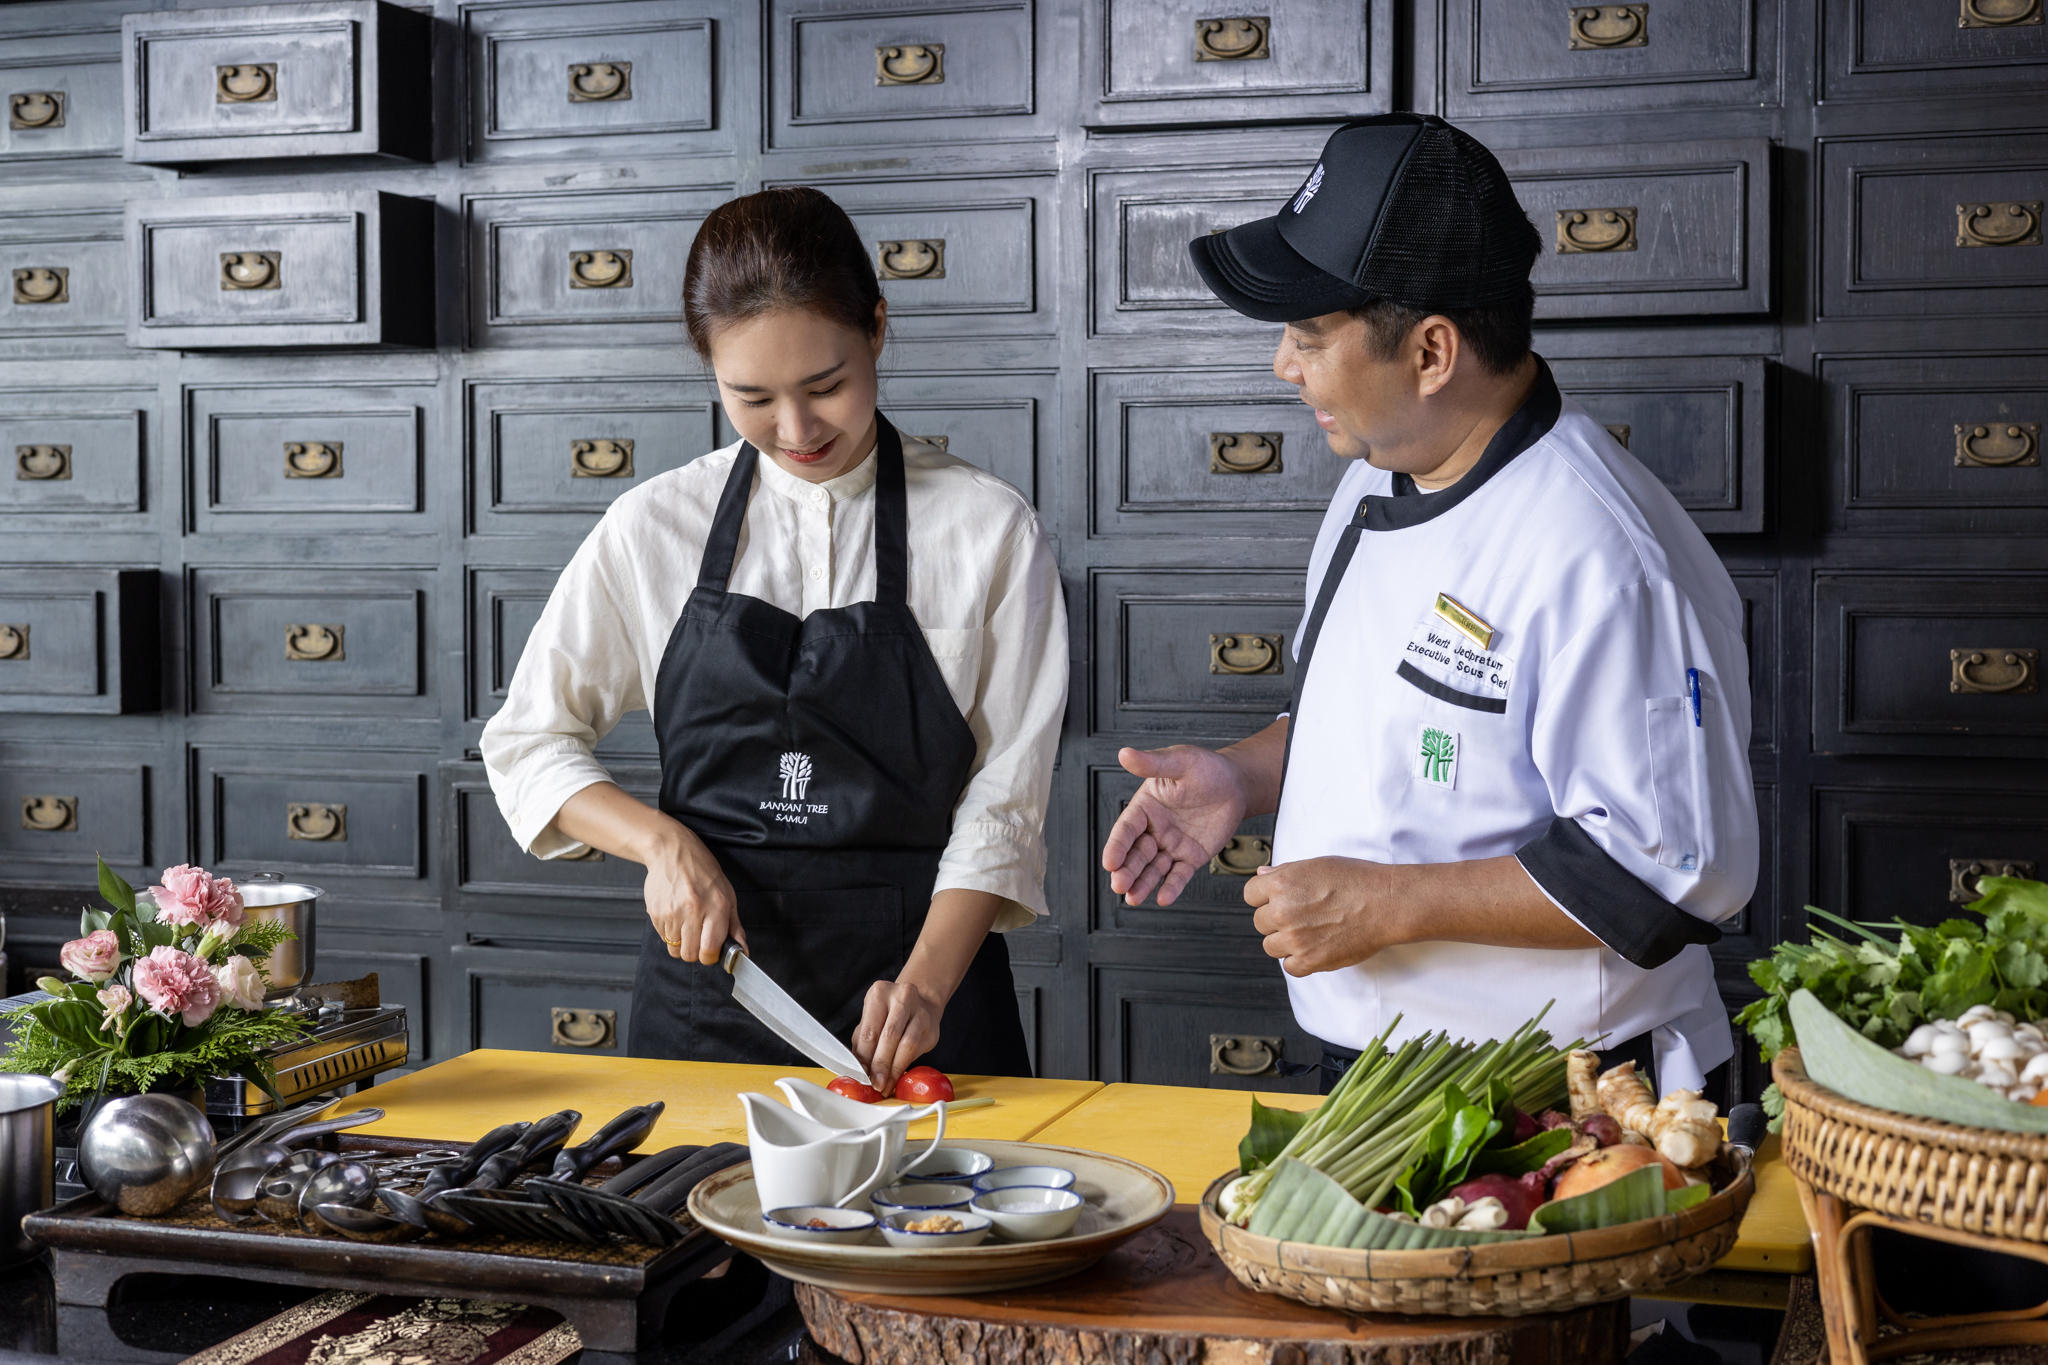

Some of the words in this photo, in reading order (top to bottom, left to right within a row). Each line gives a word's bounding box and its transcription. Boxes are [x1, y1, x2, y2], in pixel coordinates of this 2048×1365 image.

[1406, 641, 1451, 665] Executive
[1456, 660, 1484, 679] Sous
[759, 801, 802, 813] BANYAN
[806, 804, 829, 814] TREE
[775, 813, 808, 825] SAMUI
